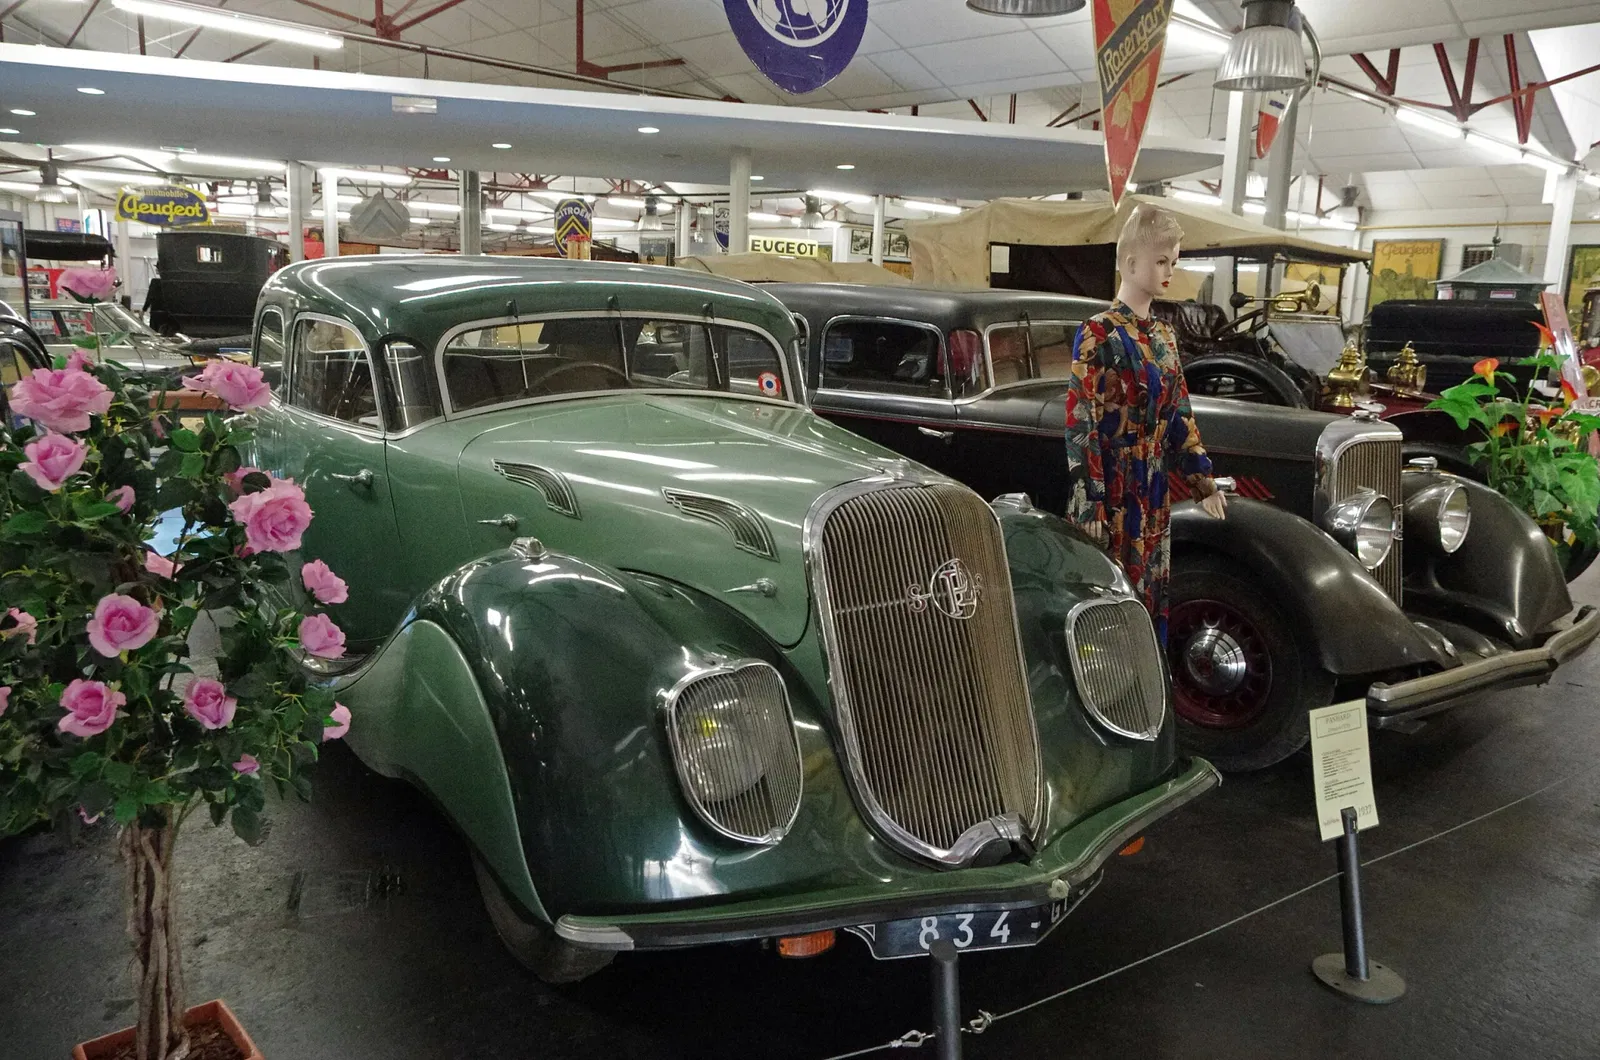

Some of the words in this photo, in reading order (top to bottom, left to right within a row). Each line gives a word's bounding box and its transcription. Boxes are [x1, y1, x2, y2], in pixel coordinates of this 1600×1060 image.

[1100, 1, 1168, 92] Rosengart
[123, 195, 204, 222] Peugeot
[751, 239, 816, 256] EUGEOT
[1381, 243, 1435, 260] Peugeot
